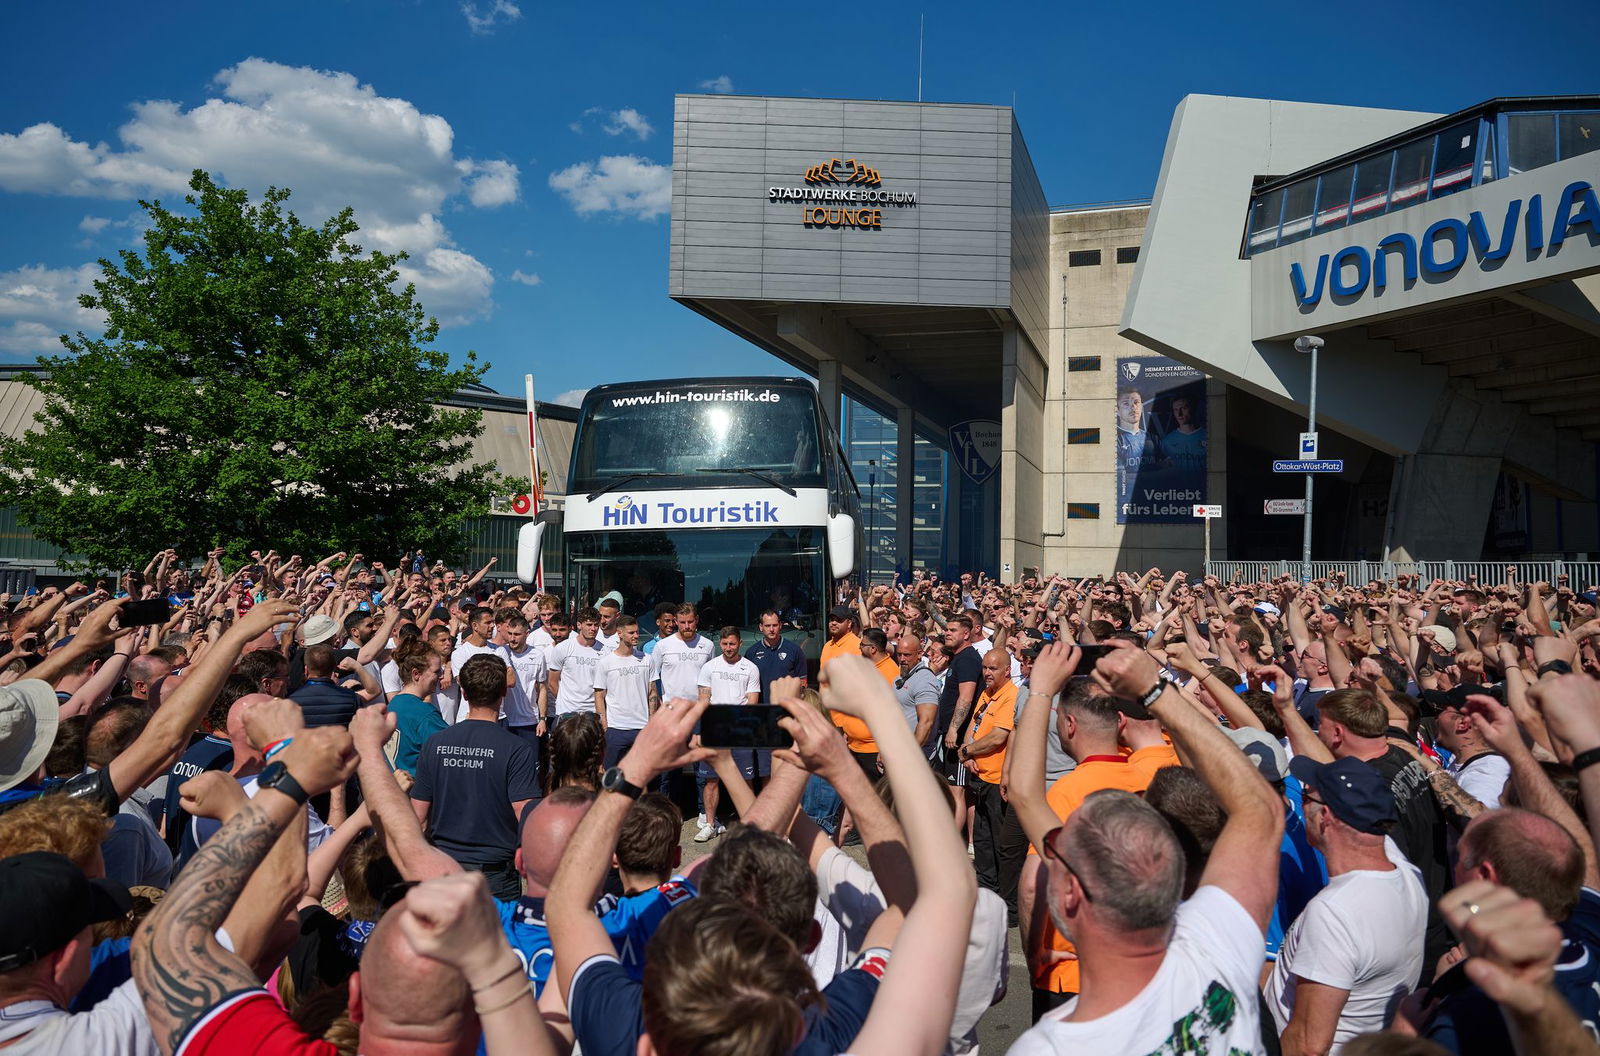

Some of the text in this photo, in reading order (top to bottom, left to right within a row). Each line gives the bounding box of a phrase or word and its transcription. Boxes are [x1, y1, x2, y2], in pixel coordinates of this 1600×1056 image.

[768, 187, 917, 203] STADTWERKE BOCHUM
[802, 207, 882, 226] LOUNGE
[611, 389, 781, 408] www.hin-touristik.de
[1275, 462, 1340, 470] Ottokar-Wüst-Platz
[1143, 489, 1201, 501] Verliebt
[657, 501, 779, 524] Touristik
[1121, 503, 1151, 515] fürs
[436, 745, 495, 759] FEUERWEHR
[443, 757, 484, 769] BOCHUM
